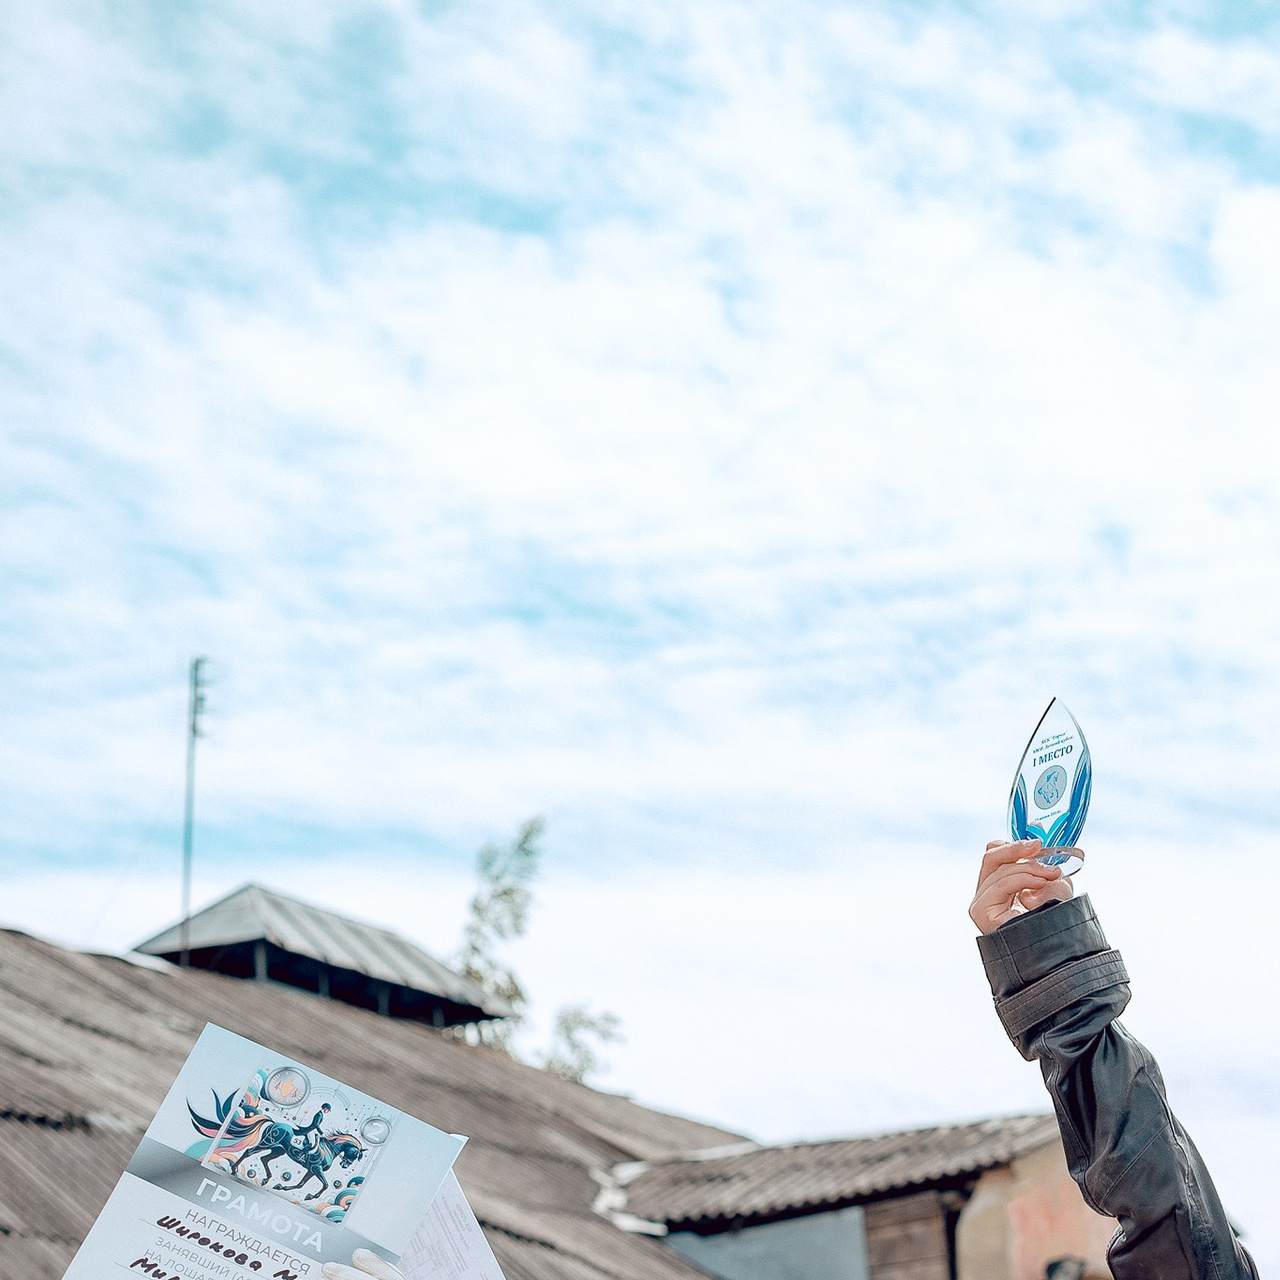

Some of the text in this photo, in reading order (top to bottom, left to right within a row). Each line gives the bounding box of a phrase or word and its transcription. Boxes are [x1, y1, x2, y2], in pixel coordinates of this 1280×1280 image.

[1038, 744, 1073, 765] МЕСТО
[366, 1122, 386, 1143] 2
[196, 1178, 329, 1253] ГРАМОТА
[144, 1249, 164, 1264] НА
[155, 1237, 232, 1279] ЗАНЯВШИЙ
[185, 1209, 311, 1276] НАГРАЖДАЕТСЯ
